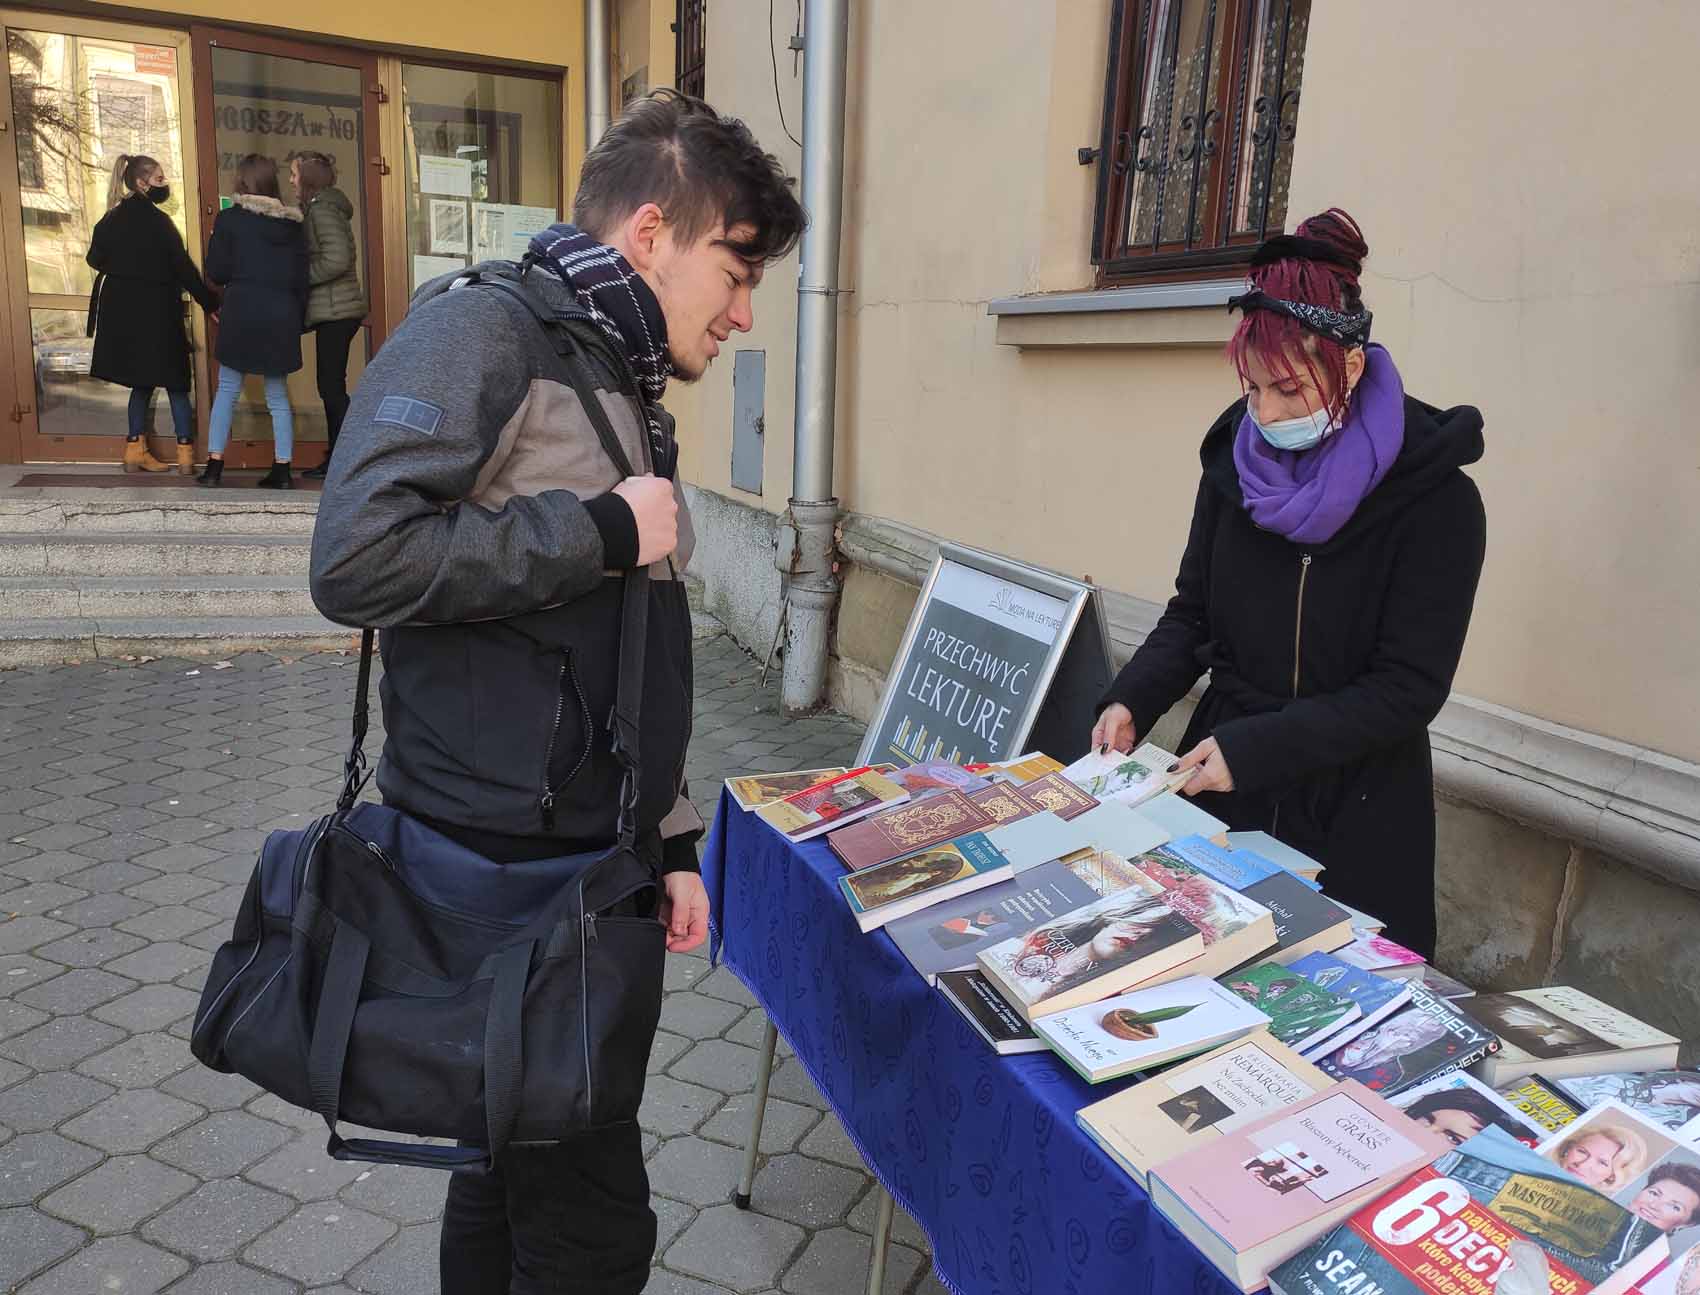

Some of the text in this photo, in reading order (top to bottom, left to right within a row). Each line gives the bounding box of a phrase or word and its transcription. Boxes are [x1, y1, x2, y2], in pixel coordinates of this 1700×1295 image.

[923, 627, 1031, 696] PRZECHWYĆ
[907, 663, 1011, 753] LEKTURĘ
[1230, 1054, 1297, 1105] REMARQUE
[1335, 1117, 1381, 1151] GRASS
[1372, 1177, 1470, 1246] 6
[1418, 1238, 1453, 1266] które
